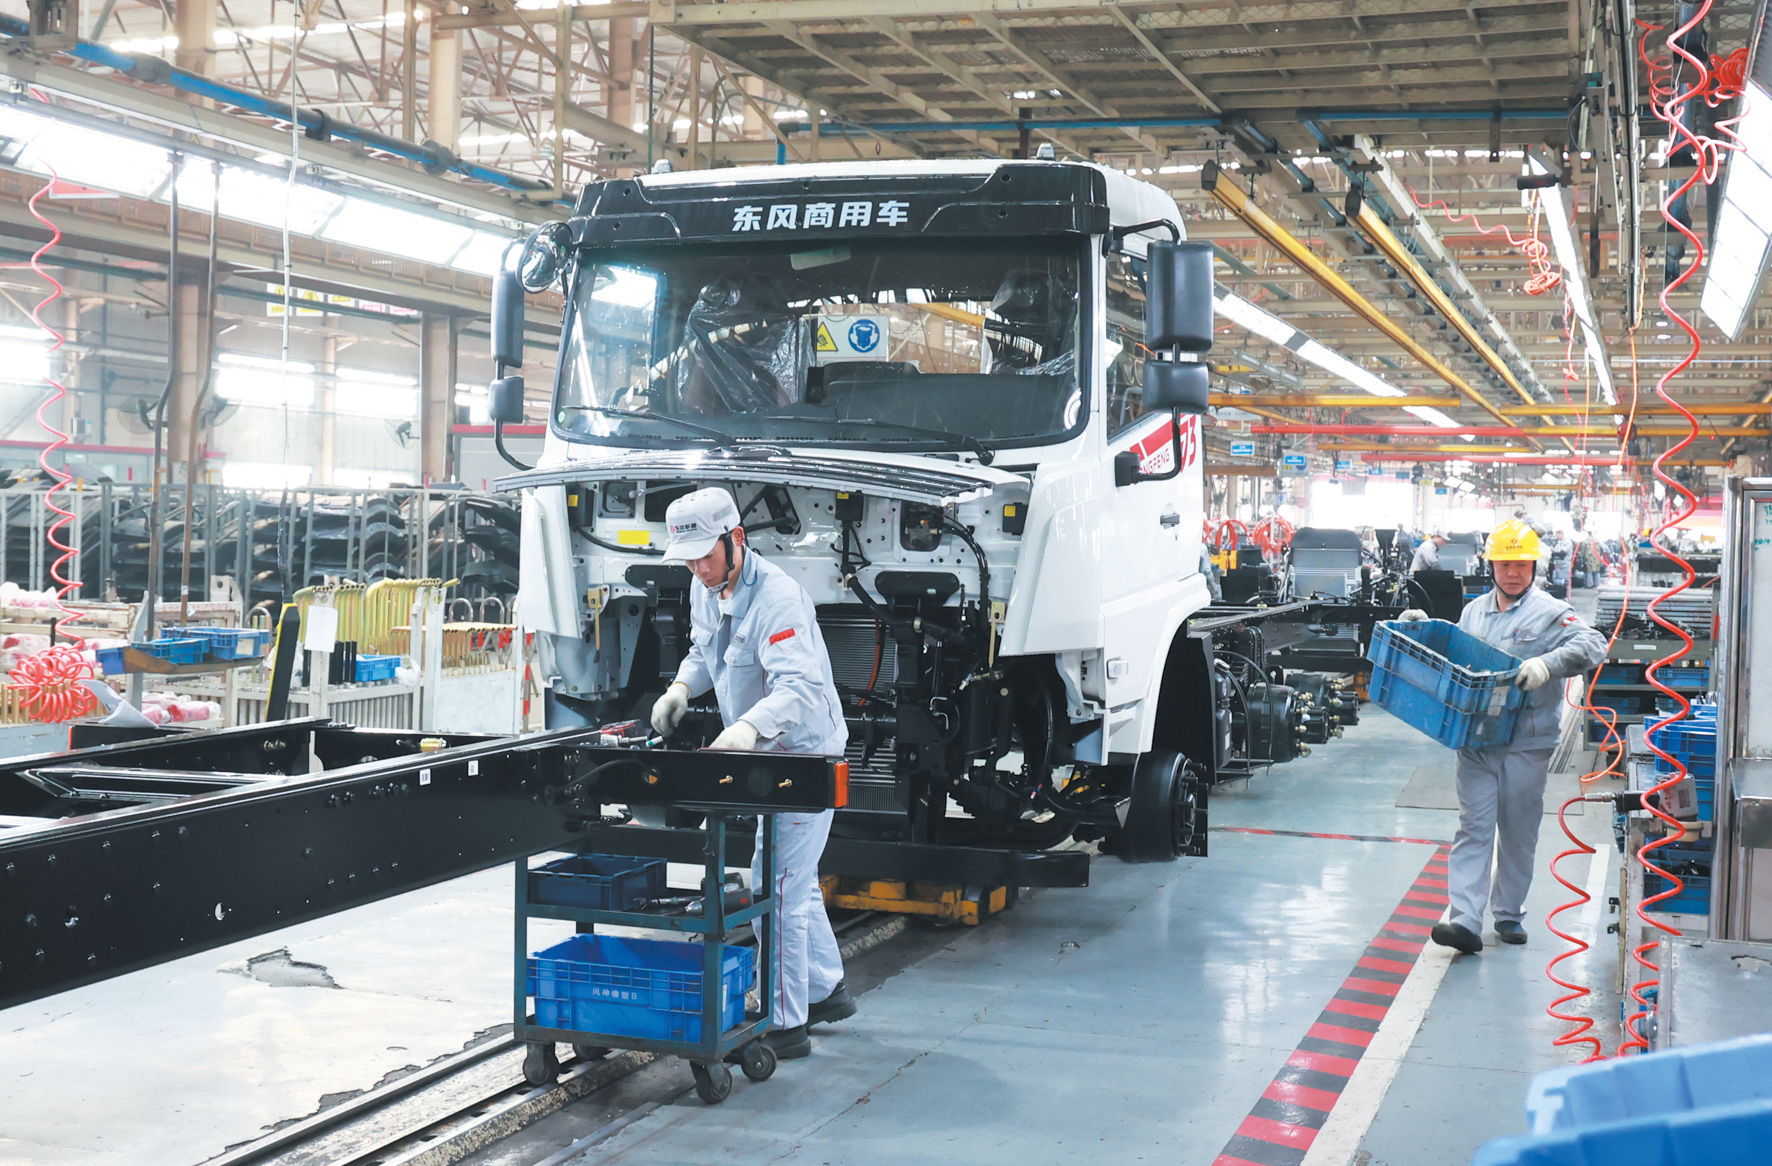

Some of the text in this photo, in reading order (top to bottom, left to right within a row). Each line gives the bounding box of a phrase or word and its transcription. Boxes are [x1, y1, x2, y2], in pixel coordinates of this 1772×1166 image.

[732, 200, 910, 231] 东风商用车
